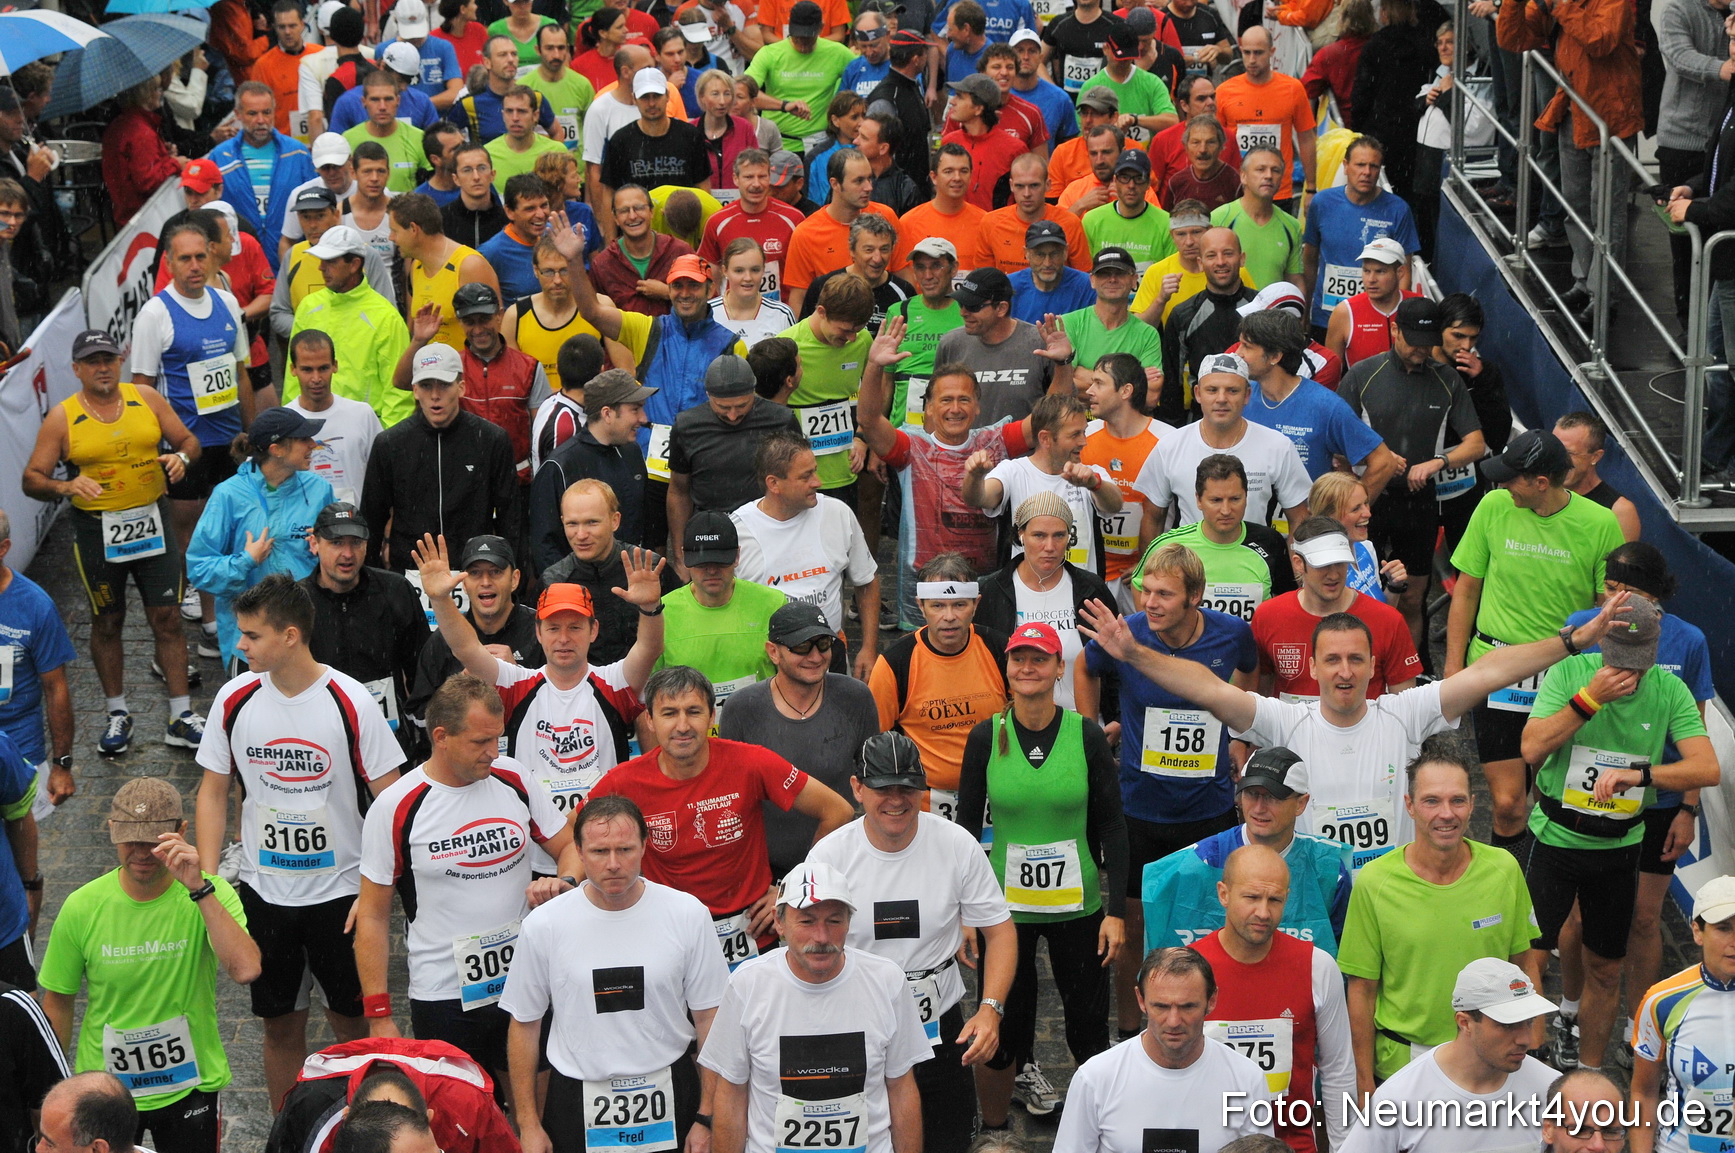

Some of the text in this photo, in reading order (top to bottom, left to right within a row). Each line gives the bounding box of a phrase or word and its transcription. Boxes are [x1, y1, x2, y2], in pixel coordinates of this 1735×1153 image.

[204, 369, 232, 393] 203
[808, 410, 848, 436] 2211
[812, 435, 850, 448] Christopher
[110, 518, 157, 545] 2224
[118, 542, 152, 554] Pasquale
[1248, 542, 1269, 559] F50
[783, 566, 831, 583] KLEBL
[1279, 660, 1299, 669] NEU
[928, 701, 976, 721] OEXL
[1170, 713, 1200, 722] BOCK
[1161, 727, 1206, 753] 158
[246, 746, 314, 761] GERHART
[1596, 754, 1627, 765] BOCK
[276, 760, 324, 773] JÄNIG
[1160, 756, 1200, 768] Andreas
[270, 783, 303, 794] sportliche
[304, 780, 333, 792] Autohaus
[687, 792, 740, 810] 11. NEUMARKTER
[696, 801, 732, 814] STADTLAUF
[1588, 797, 1617, 810] Frank
[277, 813, 307, 821] BOCK
[1336, 806, 1369, 817] BOCK
[264, 824, 327, 853] 3166
[429, 826, 506, 853] GERHART
[652, 830, 672, 840] NEU
[1322, 818, 1389, 849] 2099
[467, 837, 521, 859] JÄNIG
[1026, 847, 1057, 857] BOCK
[271, 855, 321, 868] Alexander
[431, 849, 468, 861] Autohaus
[445, 853, 526, 881] Das sportliche Autohaus
[1020, 861, 1066, 888] 807
[480, 929, 511, 945] BOCK
[124, 1029, 160, 1041] BOCK
[1228, 1025, 1264, 1034] BOCK
[111, 1037, 186, 1072] 3165
[797, 1066, 850, 1075] woodka
[131, 1073, 174, 1087] Werner
[611, 1076, 647, 1088] BOCK
[594, 1090, 667, 1126] 2320
[803, 1103, 841, 1113] BOCK
[619, 1130, 644, 1143] Fred
[784, 1116, 860, 1147] 2257
